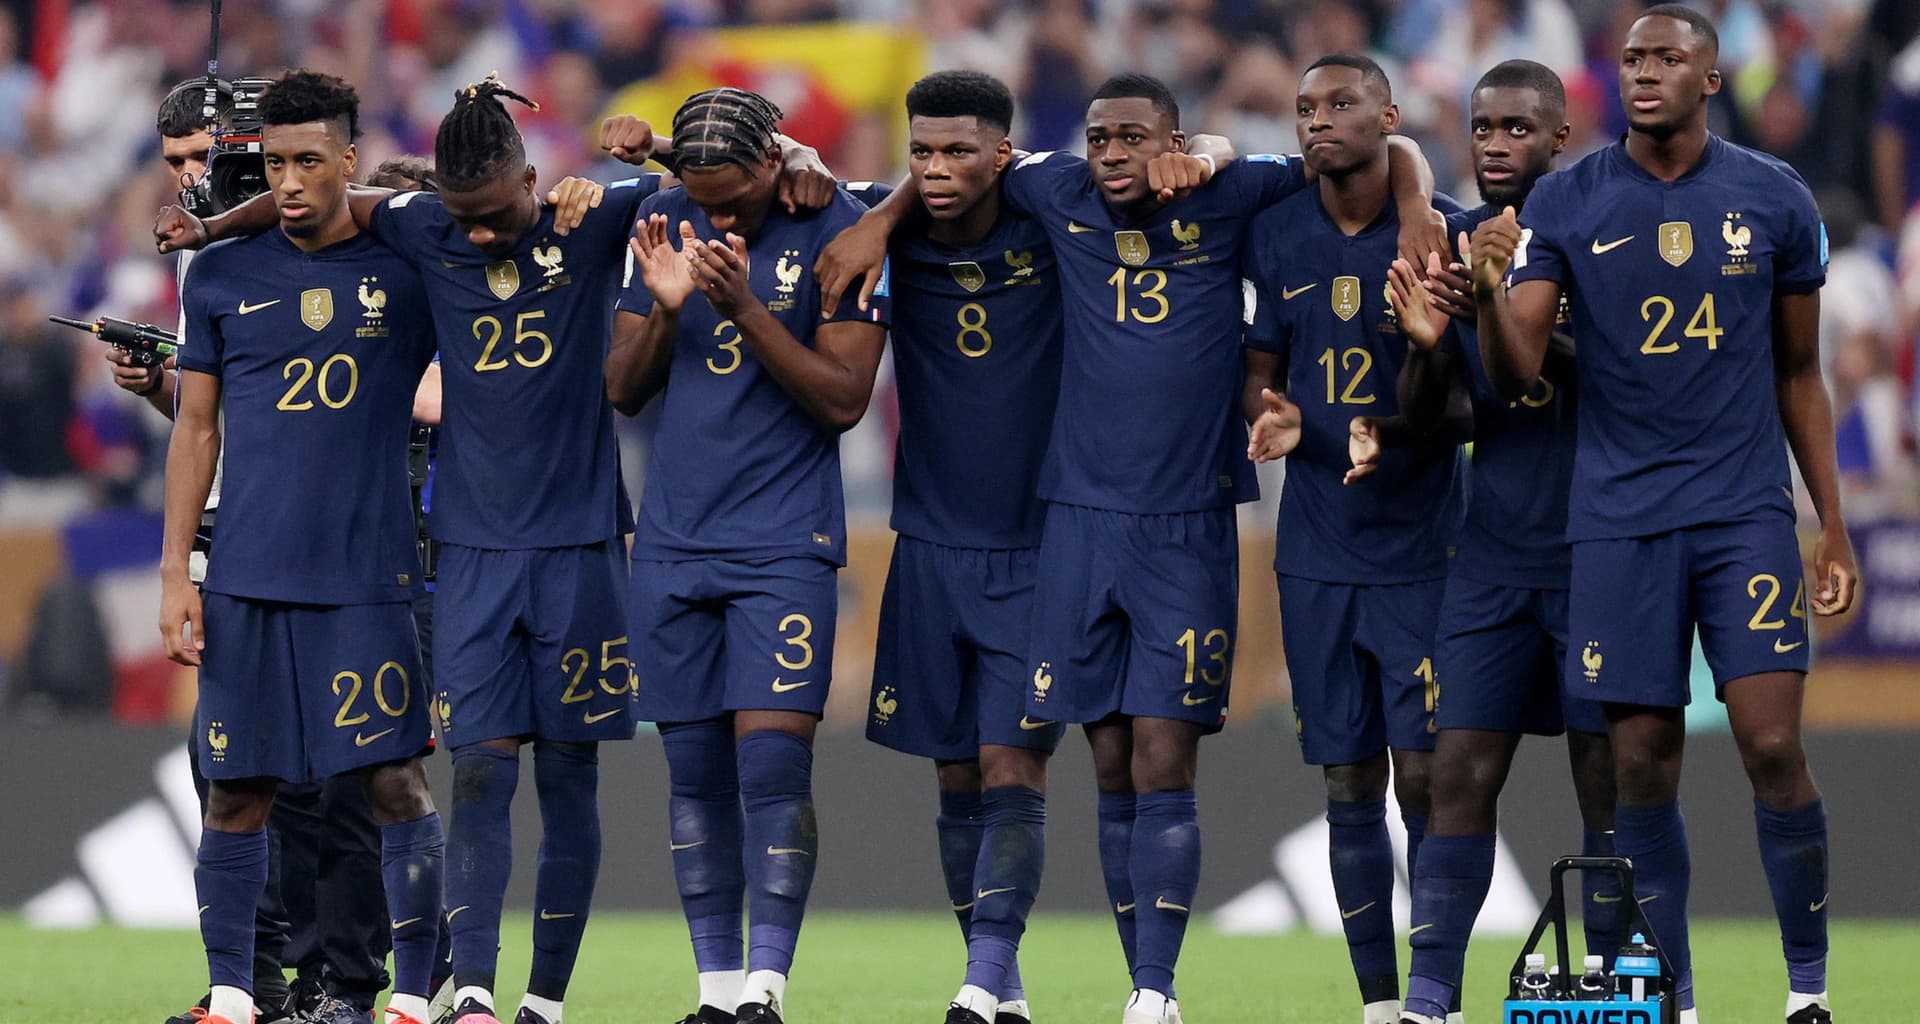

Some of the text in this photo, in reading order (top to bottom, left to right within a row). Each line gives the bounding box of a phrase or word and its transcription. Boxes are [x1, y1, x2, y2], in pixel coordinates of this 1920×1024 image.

[1108, 267, 1170, 323] 13
[472, 311, 553, 372] 25
[706, 320, 743, 374] 3
[956, 303, 992, 358] 8
[1640, 293, 1724, 355] 24
[276, 354, 358, 411] 20
[1318, 347, 1376, 404] 12
[561, 636, 630, 704] 25
[775, 614, 813, 670] 3
[1176, 629, 1229, 685] 13
[332, 661, 409, 727] 20
[1414, 657, 1434, 712] 1
